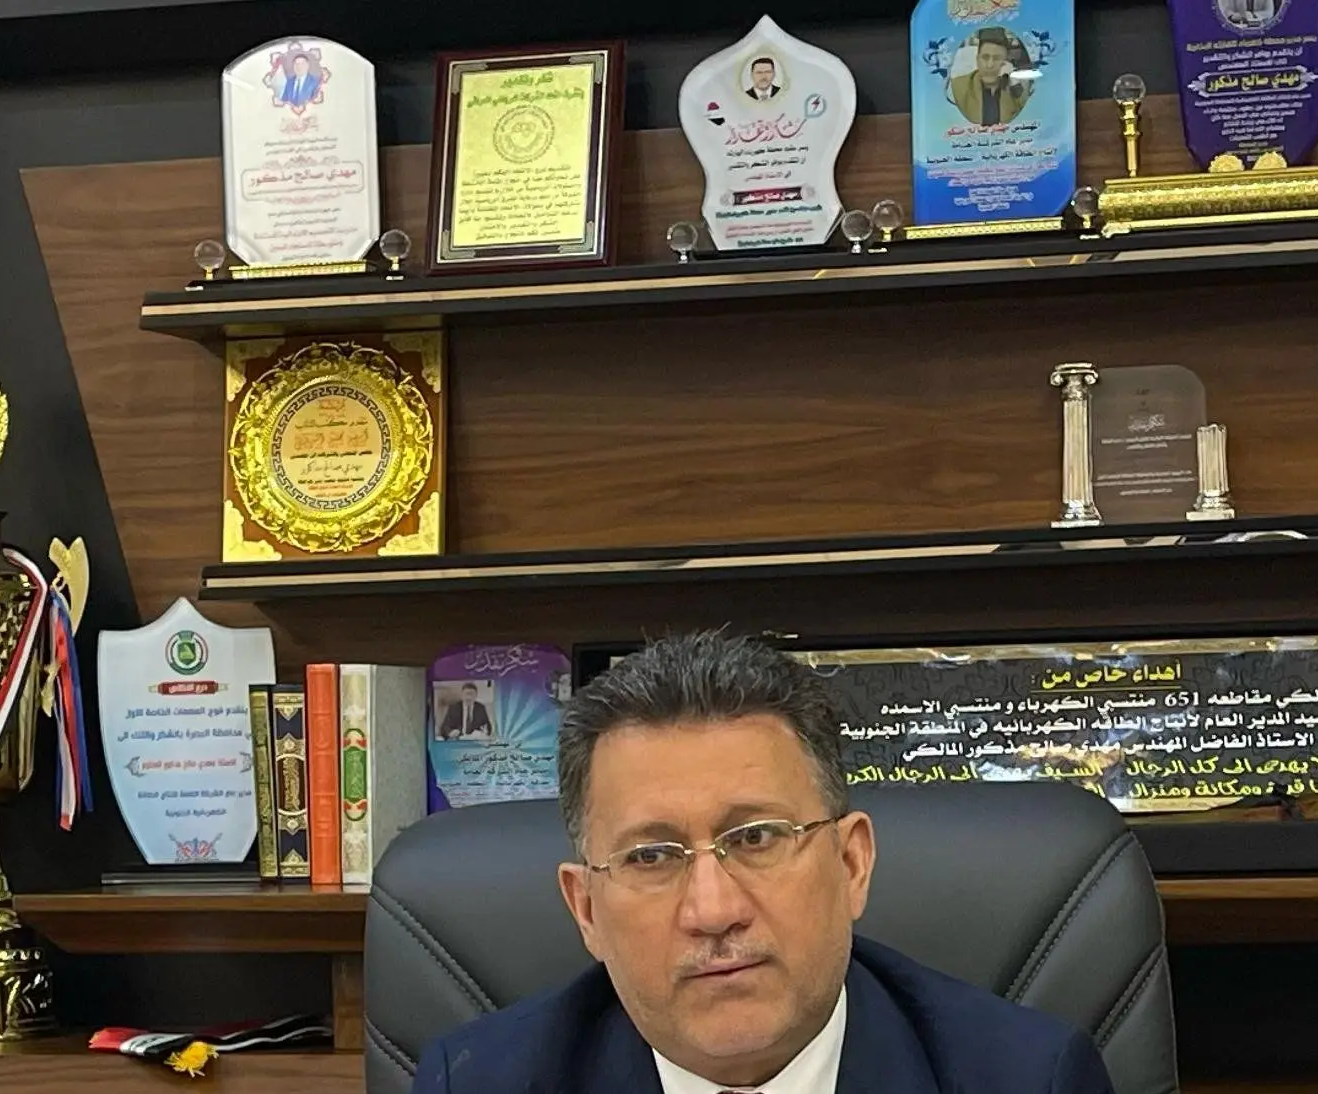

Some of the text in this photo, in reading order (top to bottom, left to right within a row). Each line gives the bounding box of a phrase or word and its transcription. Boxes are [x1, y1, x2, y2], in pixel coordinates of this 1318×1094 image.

[1042, 668, 1072, 689] من
[1076, 665, 1127, 688] خاص
[943, 697, 1001, 719] منتسبي
[1004, 701, 1014, 715] و
[1017, 695, 1094, 714] الكهرباء
[1097, 693, 1156, 714] منتسبي
[1164, 691, 1199, 707] 651
[909, 719, 965, 735] المنطقة
[1204, 713, 1243, 731] العام
[1247, 711, 1290, 730] المدير
[840, 722, 905, 740] الجنوبية
[1256, 732, 1314, 748] الاستاذ
[966, 740, 1026, 759] مذكور
[1028, 740, 1072, 759] صالح
[1124, 735, 1187, 754] المهندس
[1190, 734, 1252, 753] الفاضل
[888, 765, 946, 784] الرجال
[1035, 761, 1103, 779] السيف
[1126, 759, 1186, 778] الرجال
[1190, 756, 1220, 774] كل
